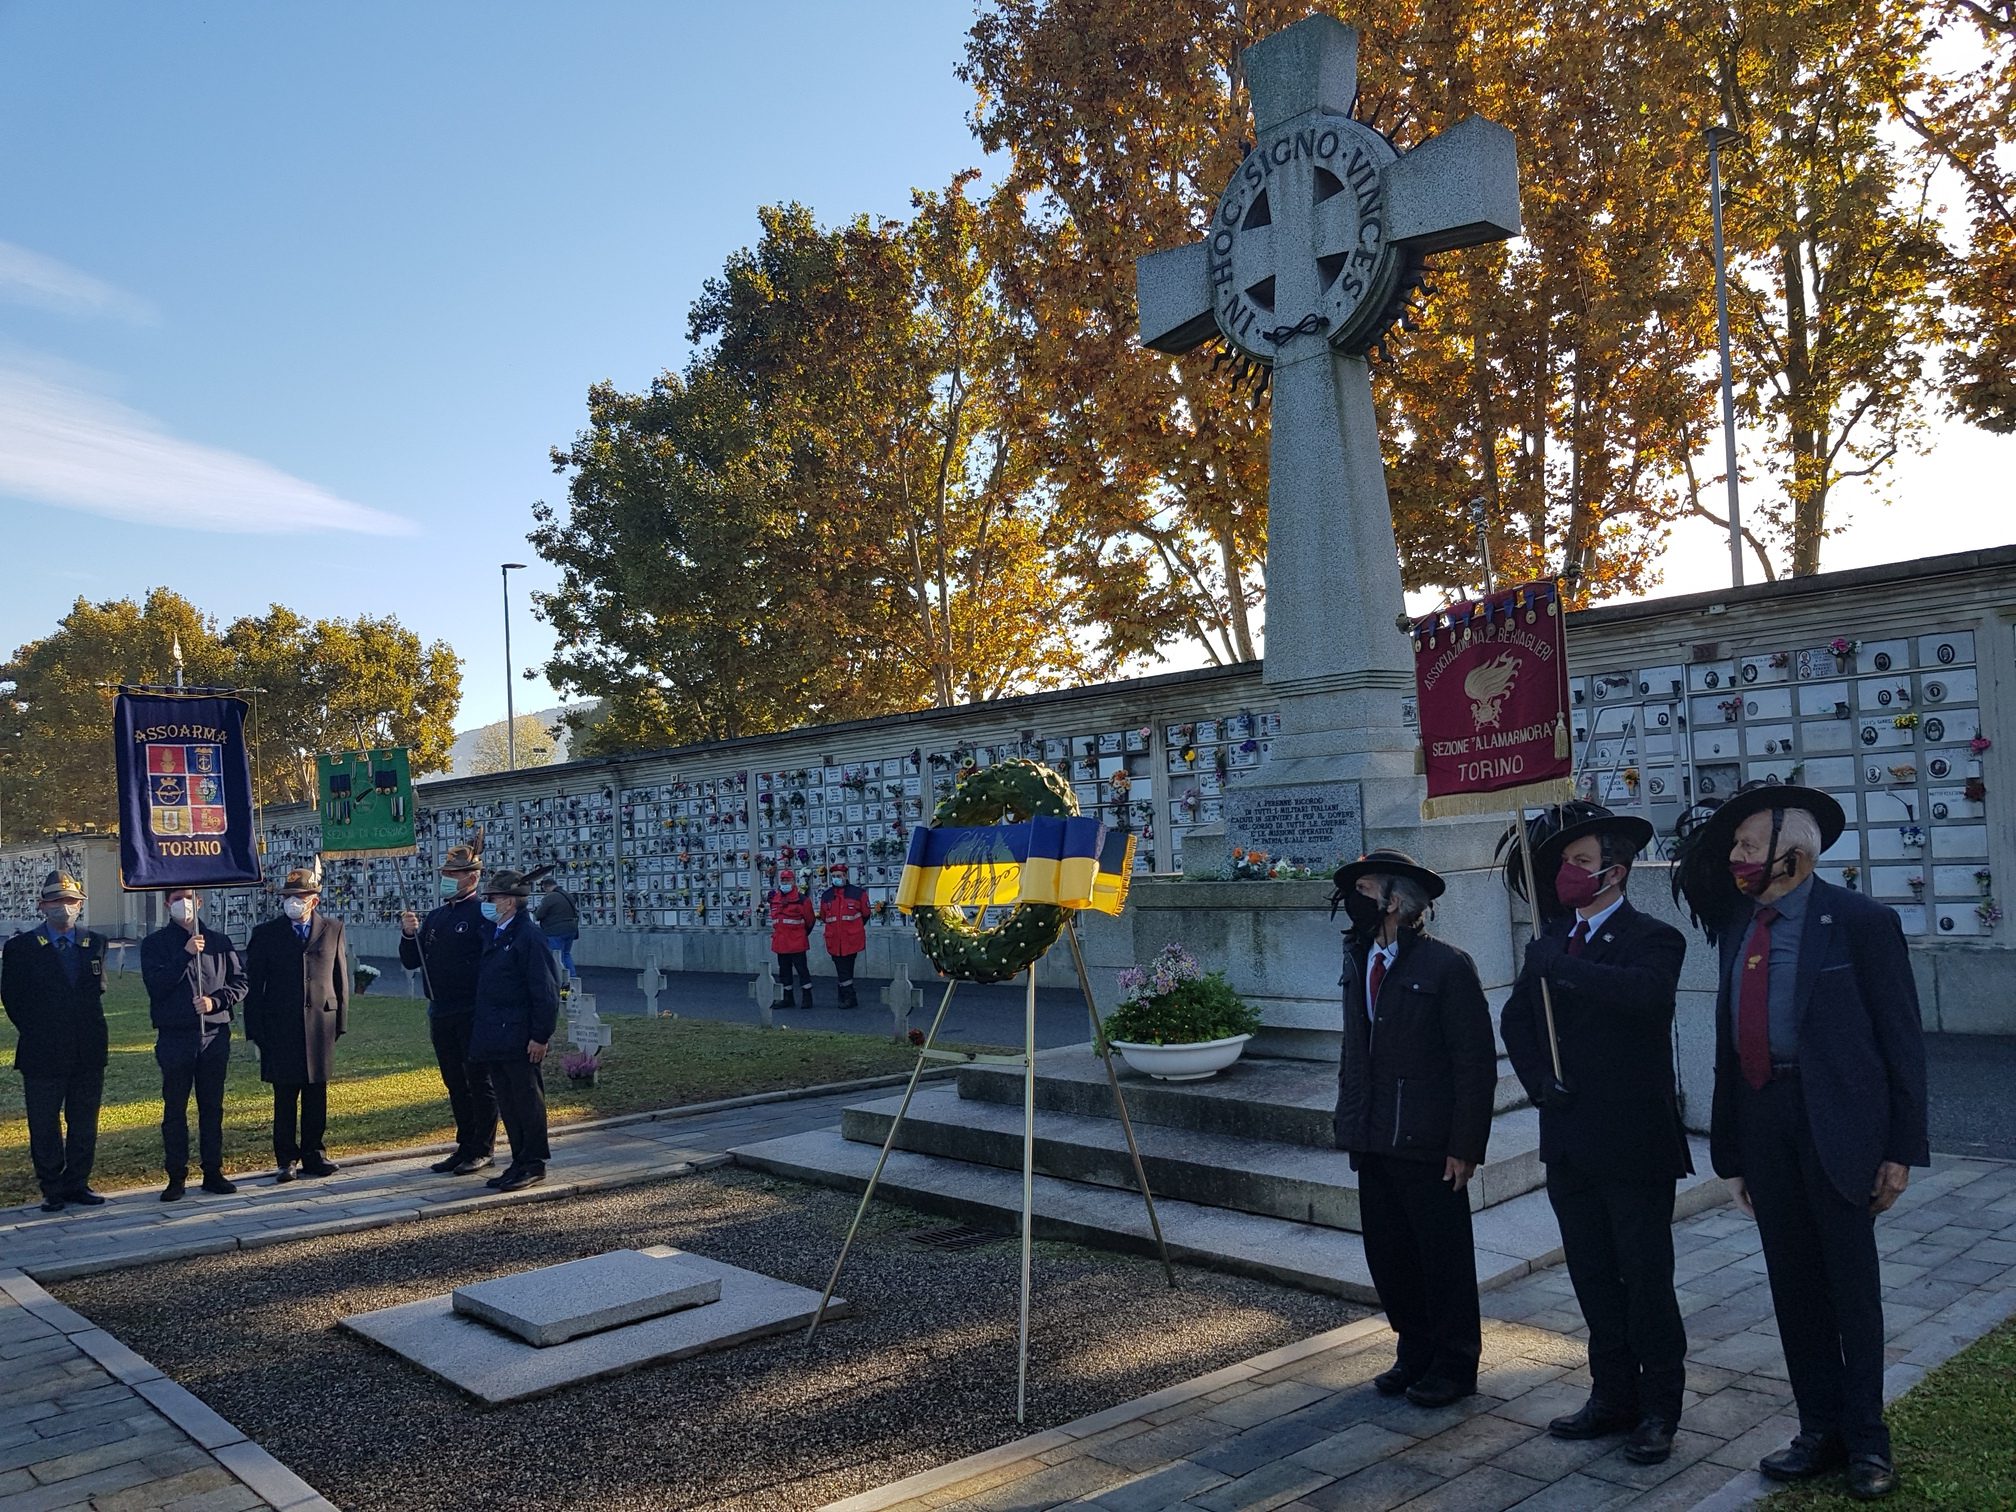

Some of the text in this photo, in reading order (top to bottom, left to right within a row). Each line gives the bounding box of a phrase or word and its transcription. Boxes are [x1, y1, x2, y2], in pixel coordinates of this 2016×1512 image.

[1213, 129, 1383, 338] IN HOC SIGNO VINCES
[1424, 639, 1472, 690] ASSOCIAZIONE
[1497, 627, 1554, 662] BERSAGLIERI
[134, 725, 228, 744] ASSOARMA
[1432, 739, 1470, 757] SEZIONE
[1458, 754, 1524, 782] TORINO
[159, 840, 221, 856] TORINO
